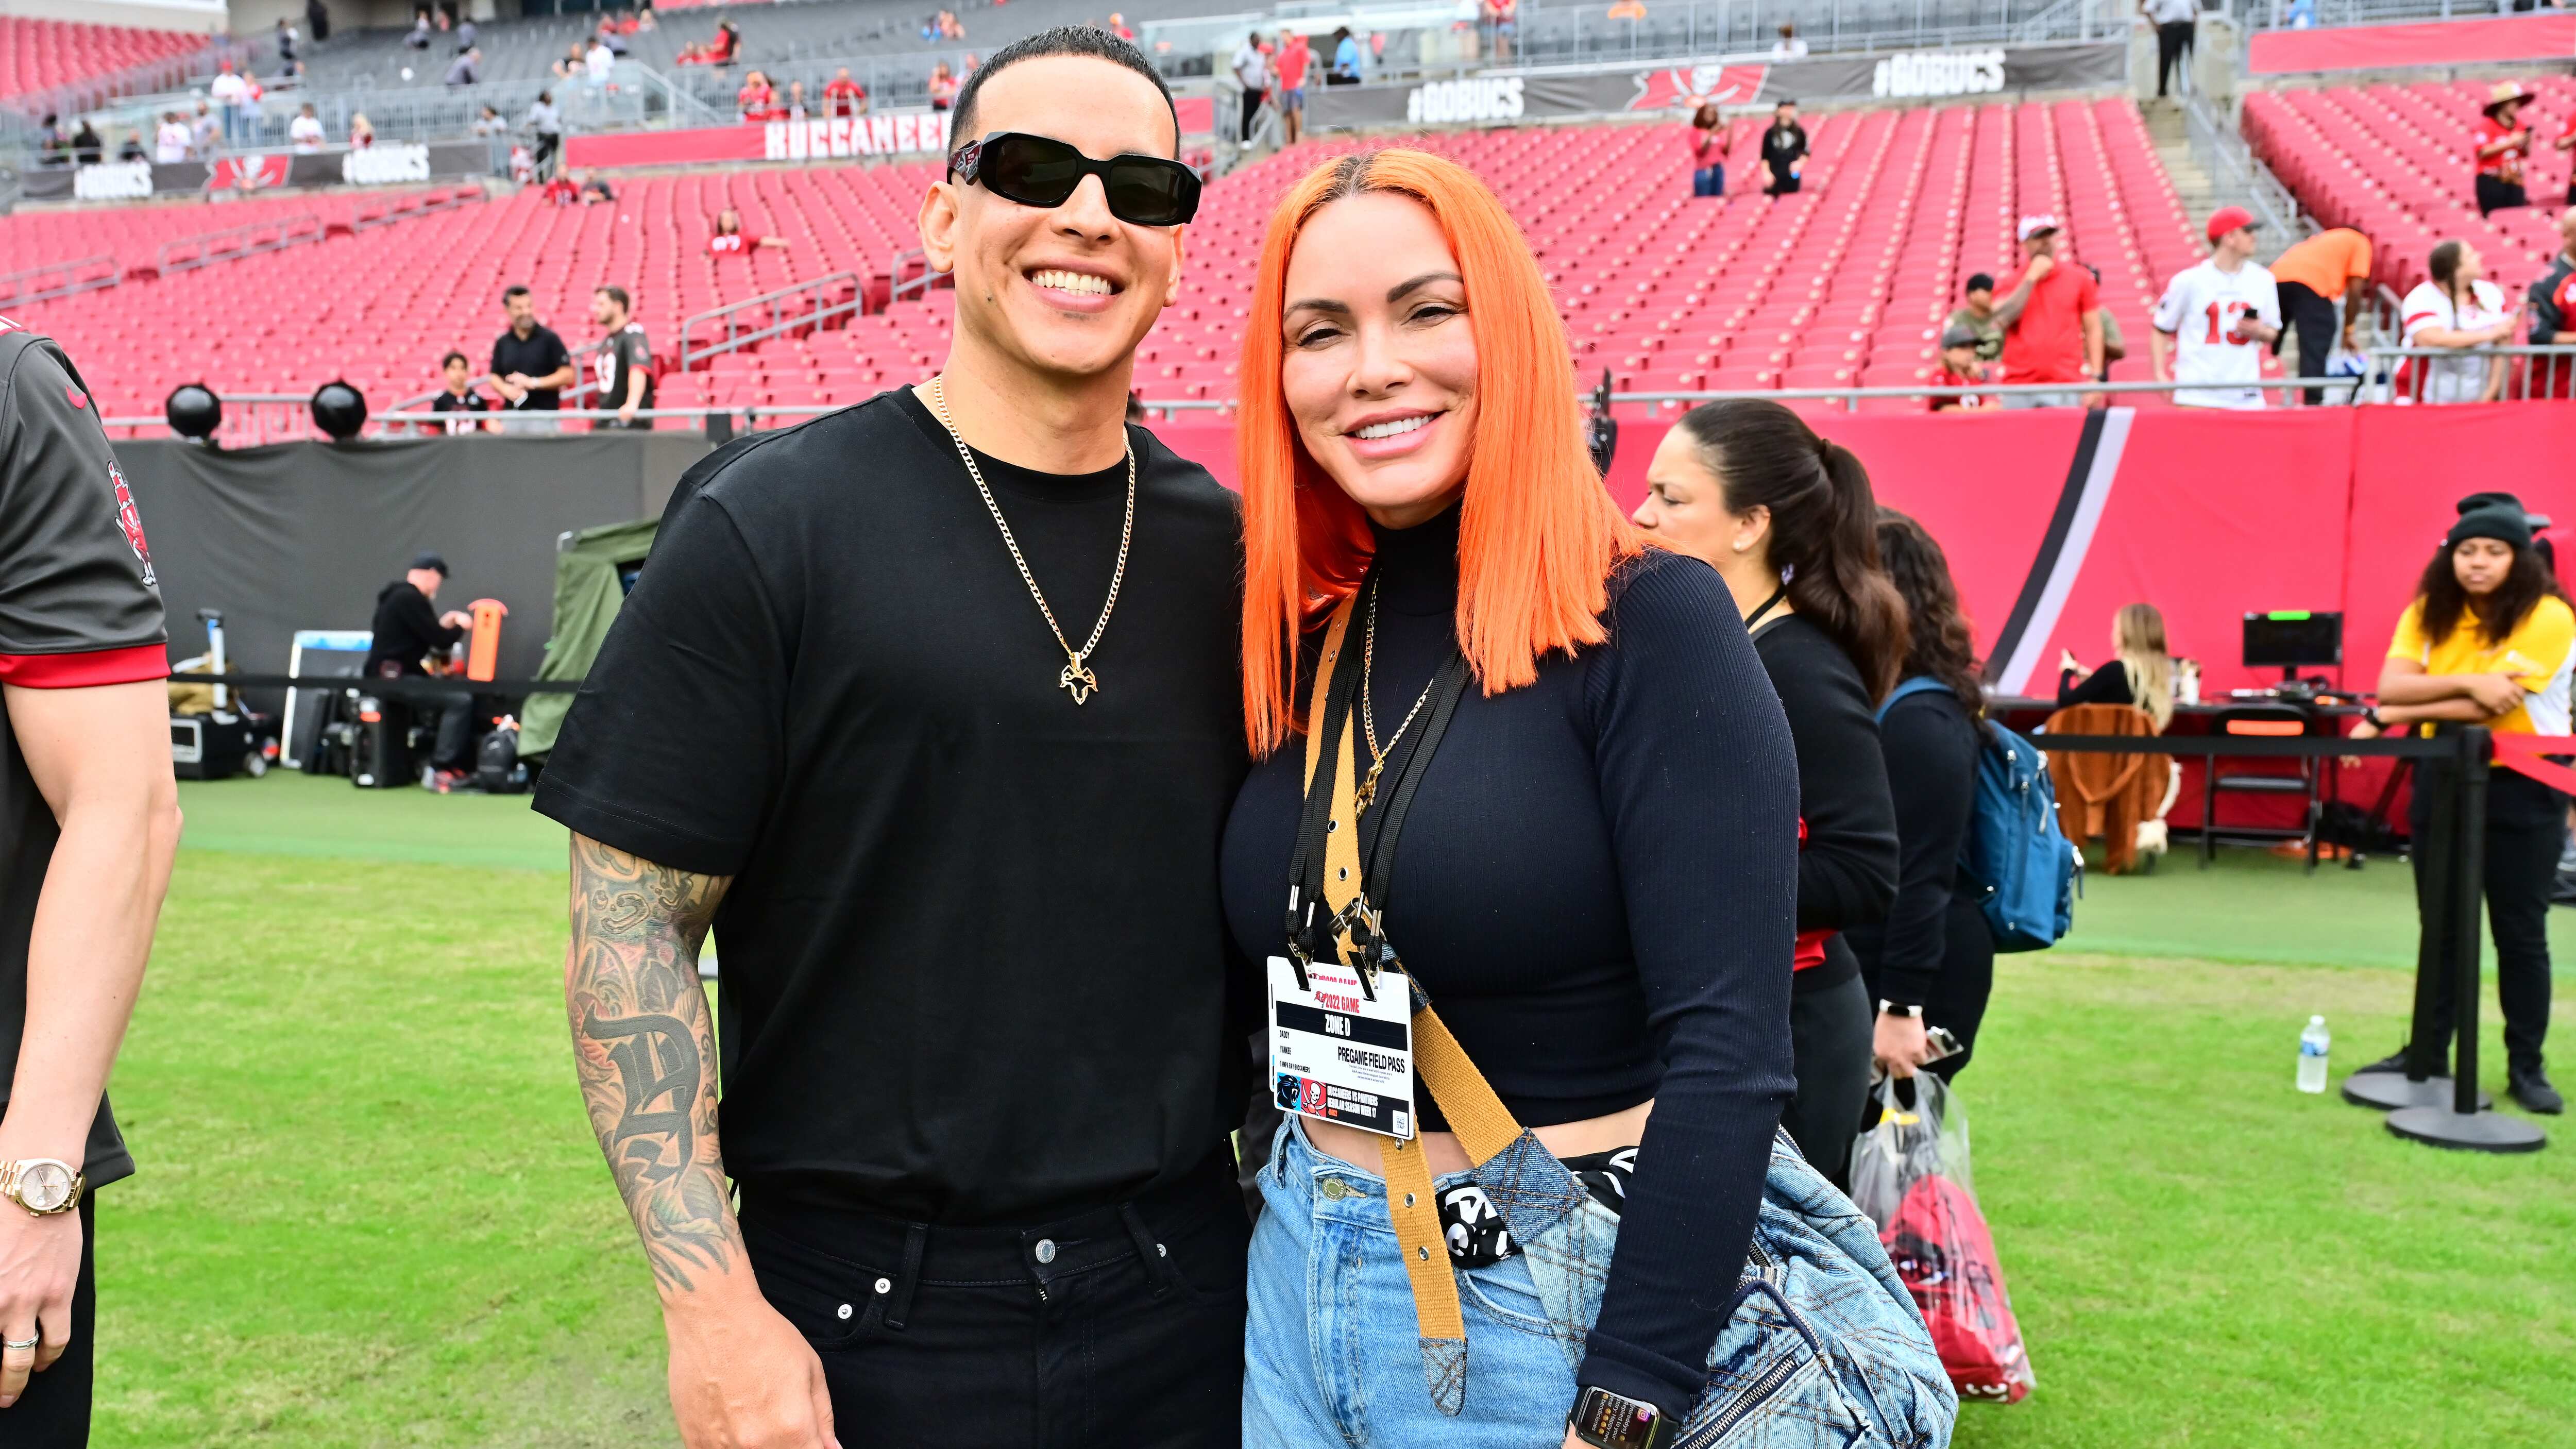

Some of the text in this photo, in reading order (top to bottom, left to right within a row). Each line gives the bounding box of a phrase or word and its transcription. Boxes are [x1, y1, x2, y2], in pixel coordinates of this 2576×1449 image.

[1873, 48, 2006, 97] #GOBUCS
[1408, 77, 1524, 123] #GOBUCS
[1326, 993, 1360, 1013] 2022 GAME
[1279, 1030, 1290, 1039] DADDY
[1325, 1014, 1350, 1037] ZONE D
[1280, 1045, 1291, 1055] YANKEE
[1338, 1046, 1405, 1073] PREGAME FIELD PASS
[1327, 1085, 1378, 1107] BUCCANEERS VS PANTHERS
[1327, 1097, 1345, 1111] REGULAR
[1345, 1101, 1360, 1115] SEASON
[1360, 1104, 1371, 1117] WEEK
[1371, 1107, 1377, 1118] 17
[1591, 1399, 1606, 1431] bendiciones
[1613, 1398, 1621, 1413] story:
[1618, 1402, 1629, 1423] Replied
[1606, 1413, 1617, 1433] Happy
